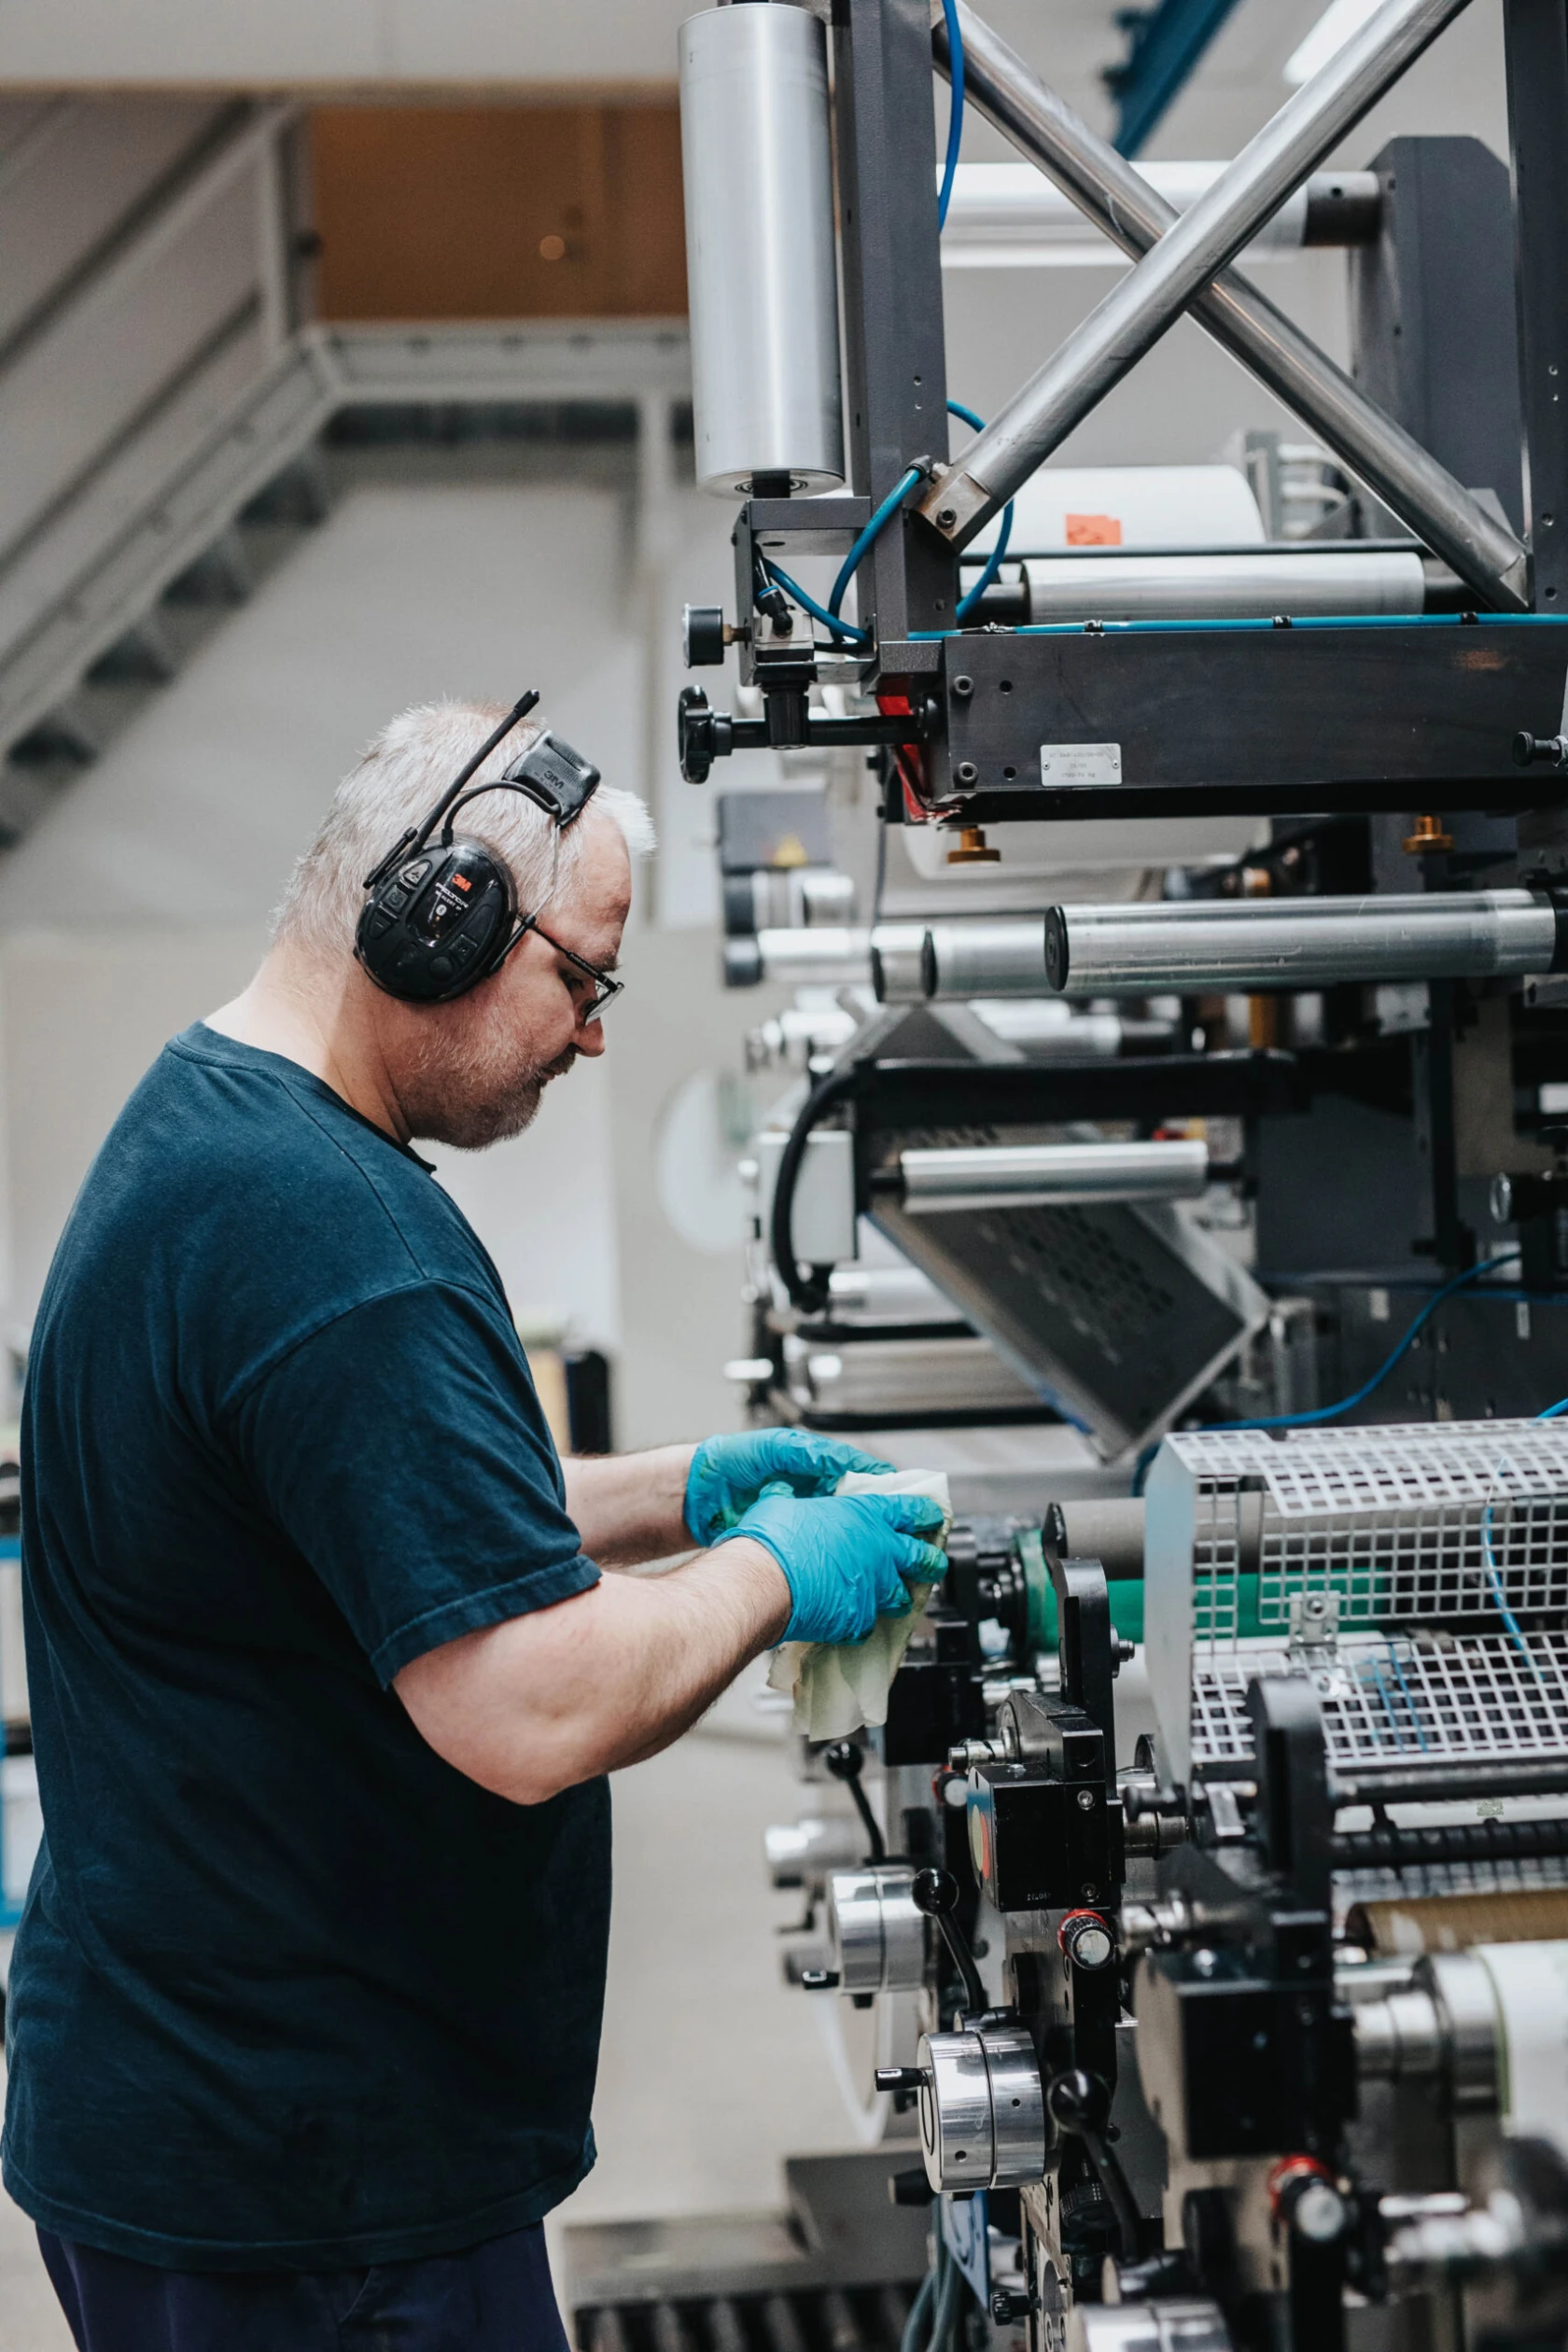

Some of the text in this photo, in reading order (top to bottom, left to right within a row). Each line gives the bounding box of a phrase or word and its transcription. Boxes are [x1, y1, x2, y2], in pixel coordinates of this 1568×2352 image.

[543, 770, 565, 790] 3M
[452, 873, 473, 893] 3M
[435, 882, 469, 908] PELTOR
[441, 895, 456, 906] ALERT
